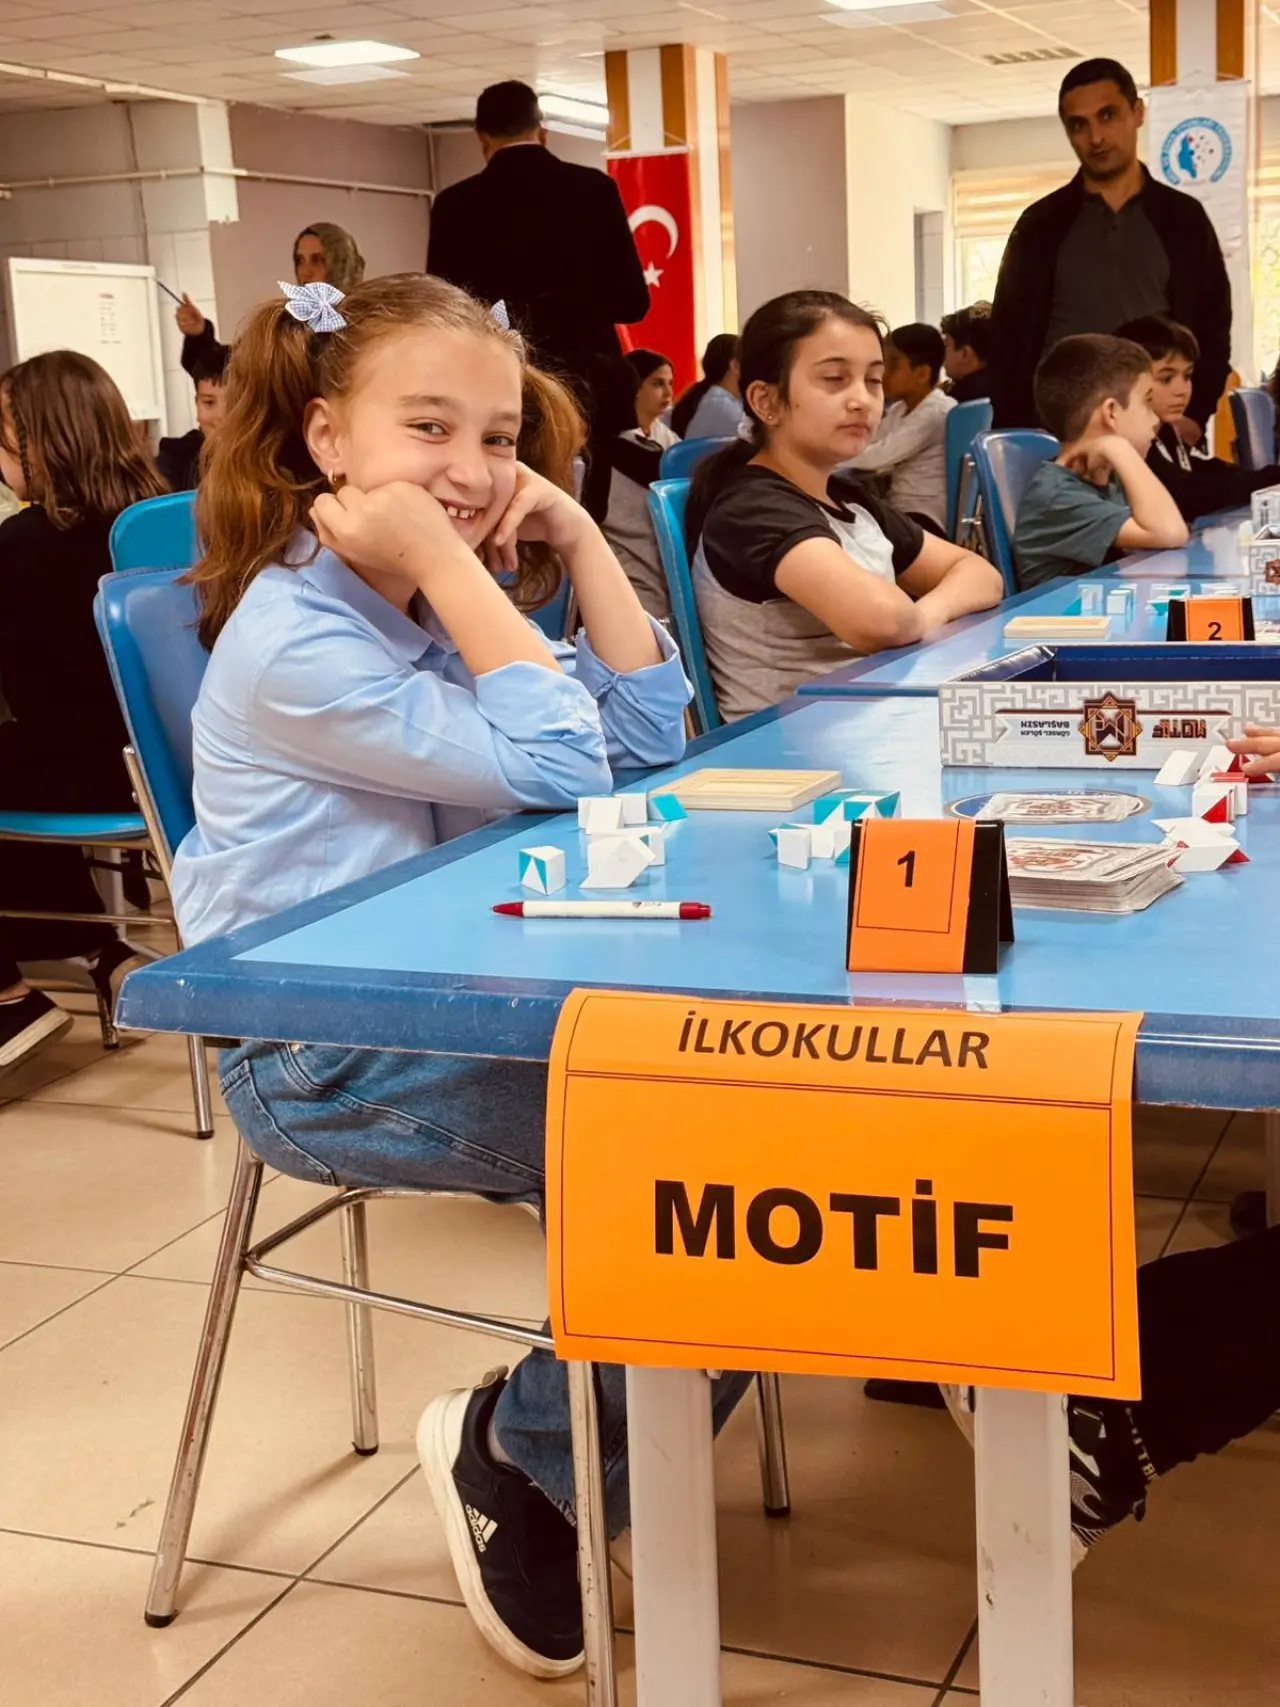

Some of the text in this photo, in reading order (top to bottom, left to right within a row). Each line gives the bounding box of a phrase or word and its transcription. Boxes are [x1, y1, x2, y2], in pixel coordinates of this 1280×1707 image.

[1207, 621, 1222, 641] 2
[897, 850, 916, 888] 1
[678, 1010, 990, 1069] İLKOKULLAR
[655, 1178, 1013, 1278] MOTİF
[465, 1503, 486, 1552] adidas
